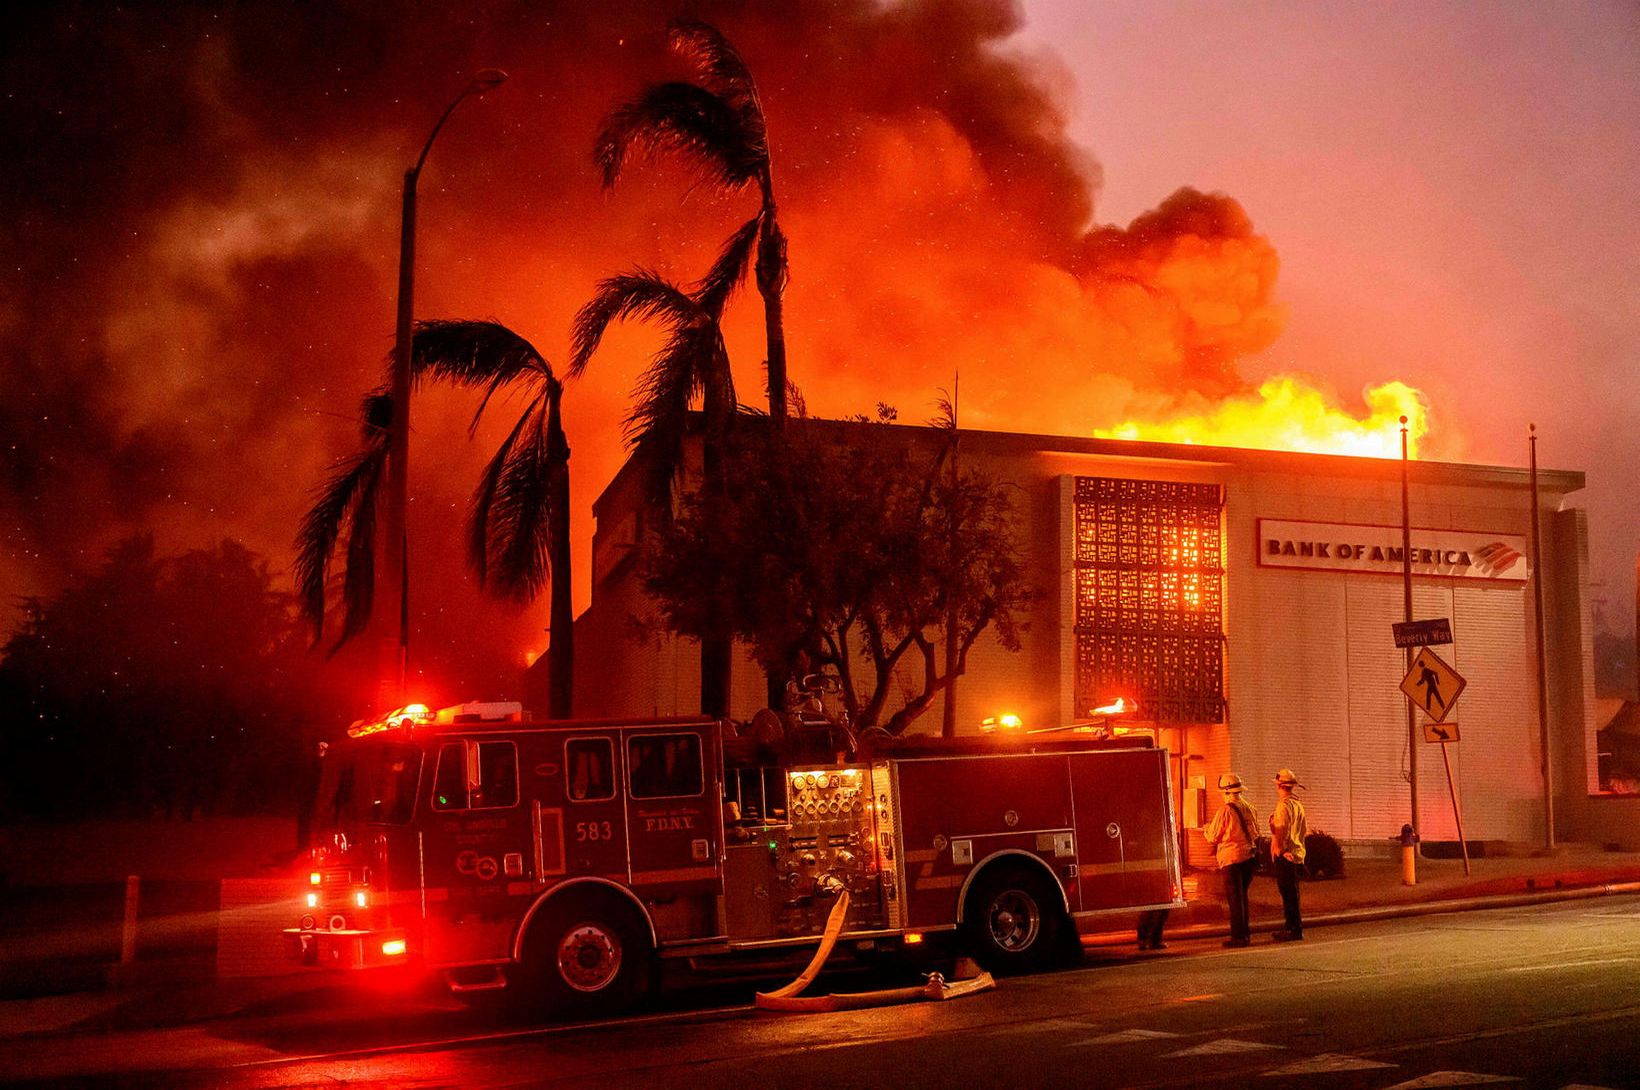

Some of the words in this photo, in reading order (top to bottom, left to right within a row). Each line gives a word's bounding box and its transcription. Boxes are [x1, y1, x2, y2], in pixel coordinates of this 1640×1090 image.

[1266, 539, 1331, 558] BANK
[1336, 543, 1366, 560] OF
[1370, 545, 1472, 566] AMERICA
[575, 821, 612, 842] 583
